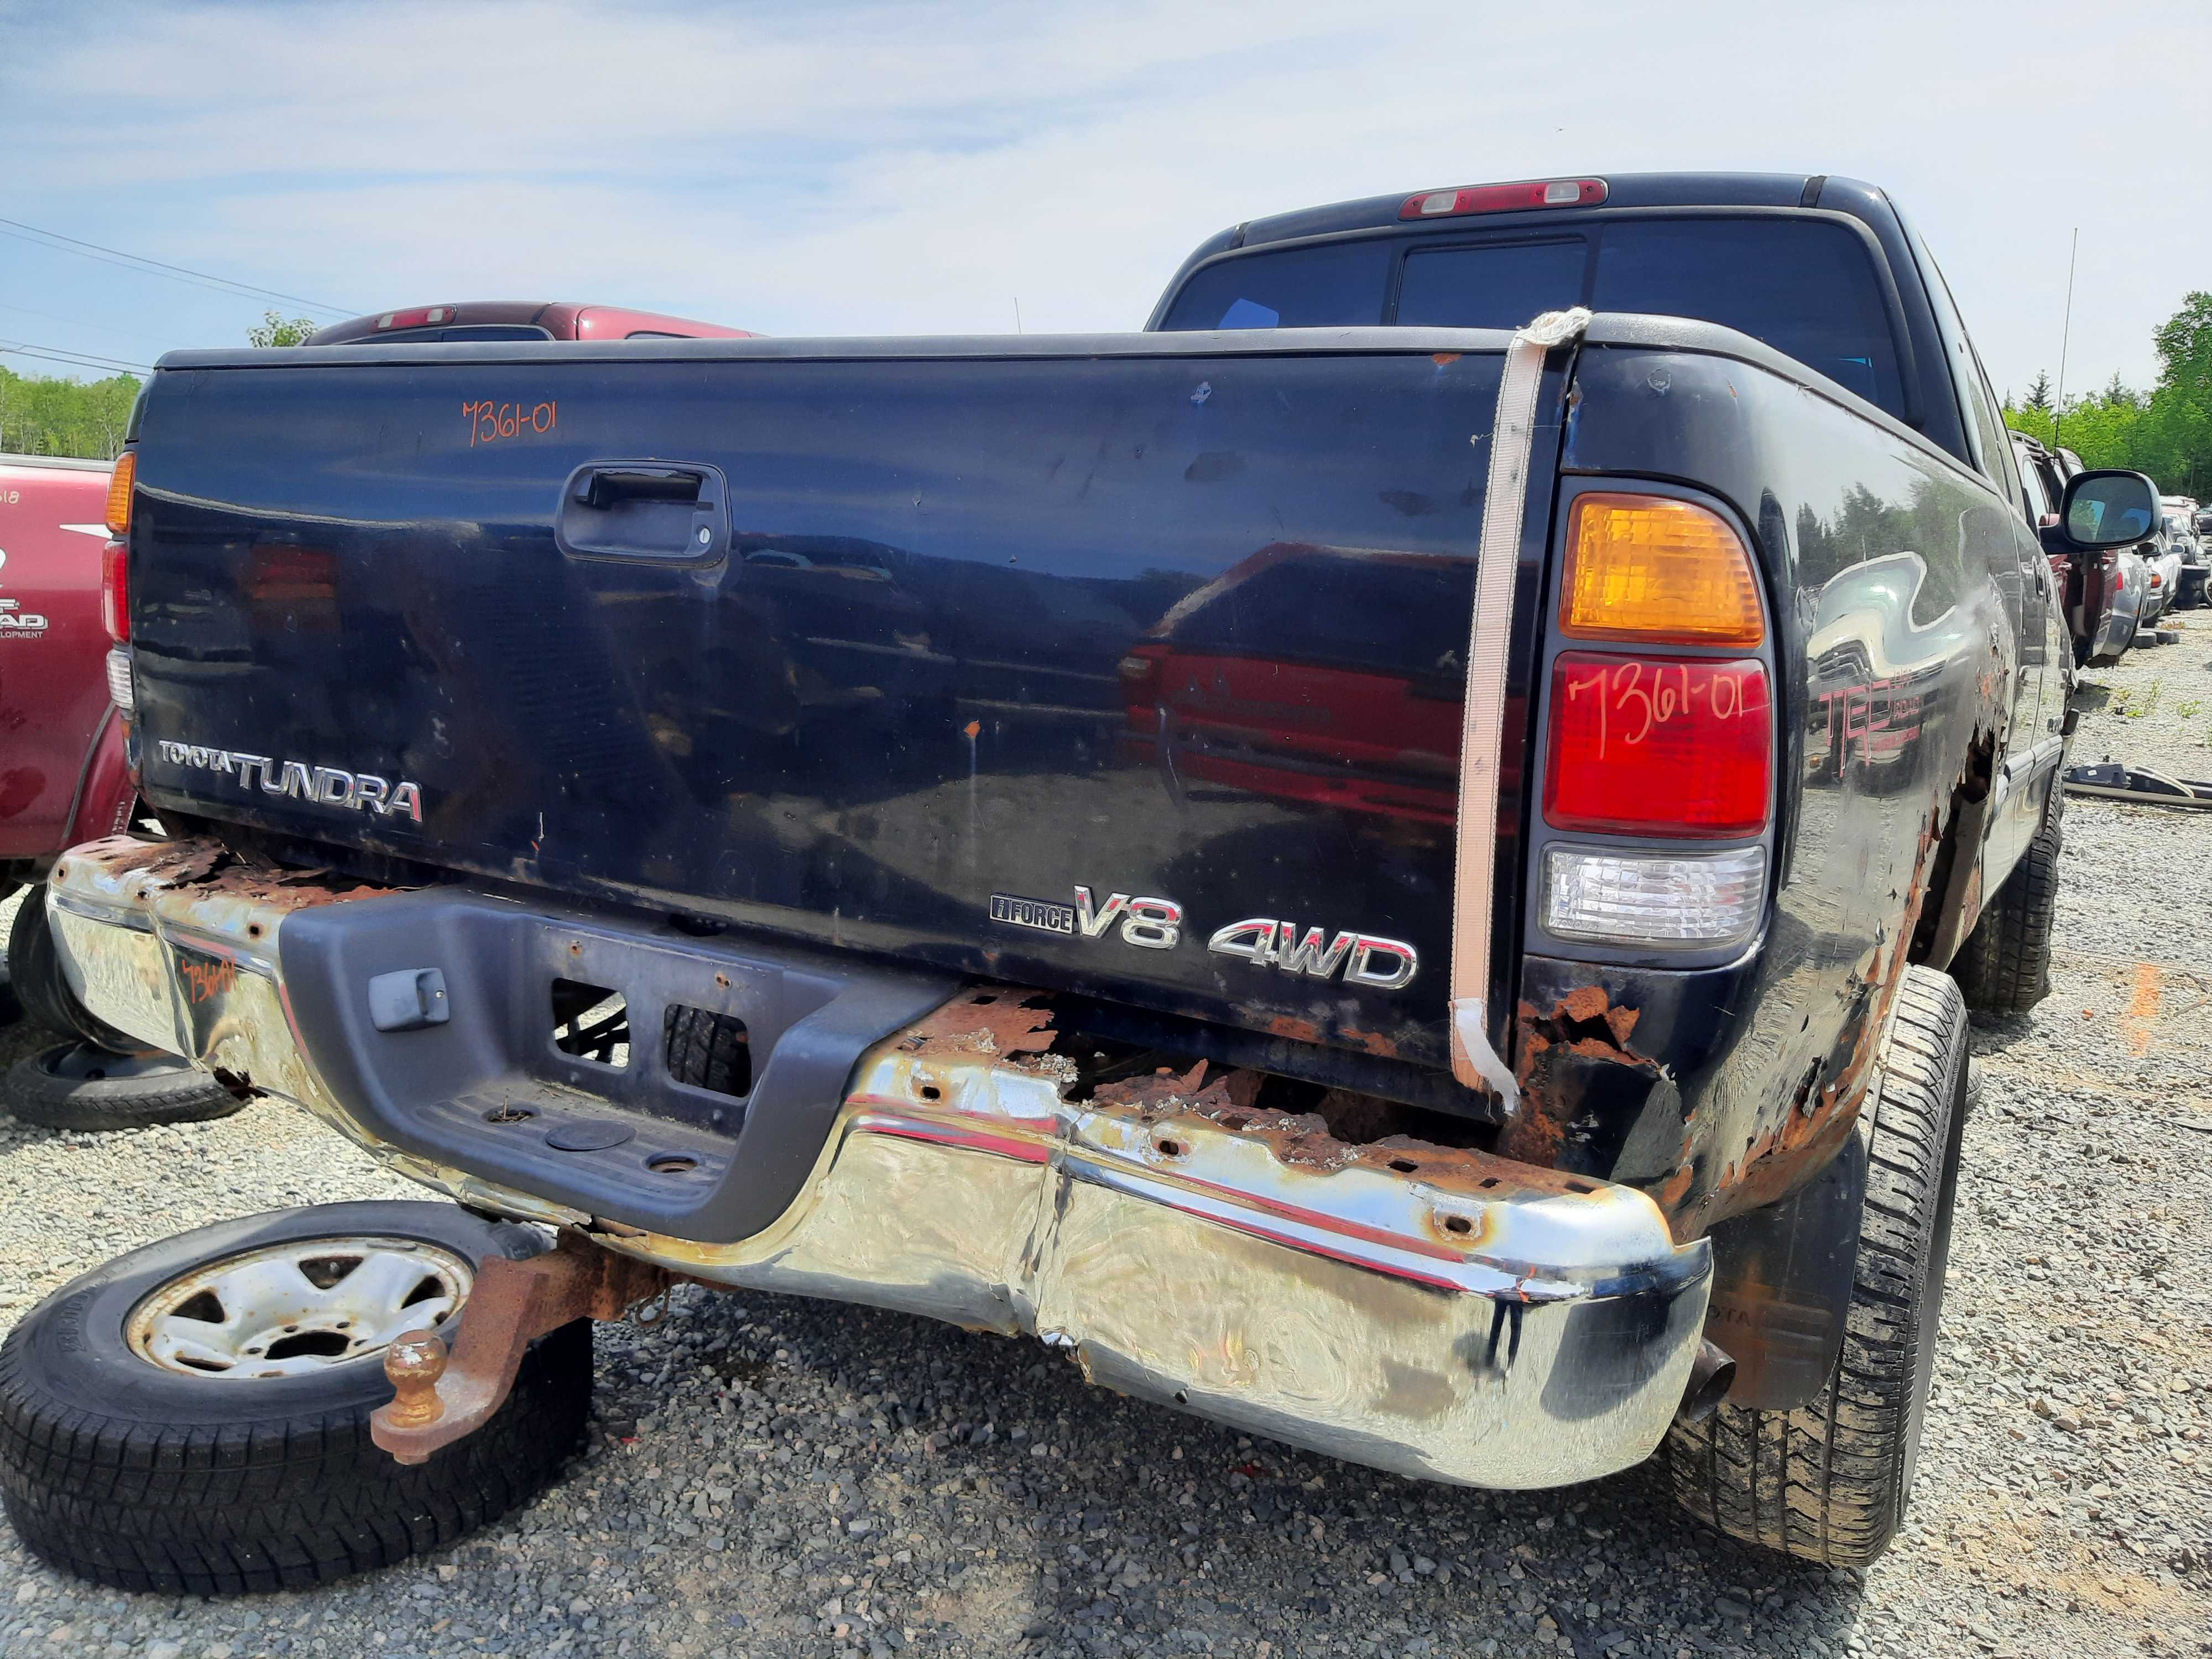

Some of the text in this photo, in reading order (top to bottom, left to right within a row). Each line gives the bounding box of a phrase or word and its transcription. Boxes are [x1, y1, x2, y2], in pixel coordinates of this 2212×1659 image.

[462, 400, 557, 447] 7361-01
[1568, 662, 1744, 760] 7361-01
[159, 739, 423, 822] TOYOTA TUNDRA
[1073, 885, 1184, 950] V8
[1207, 917, 1420, 991] 4WD
